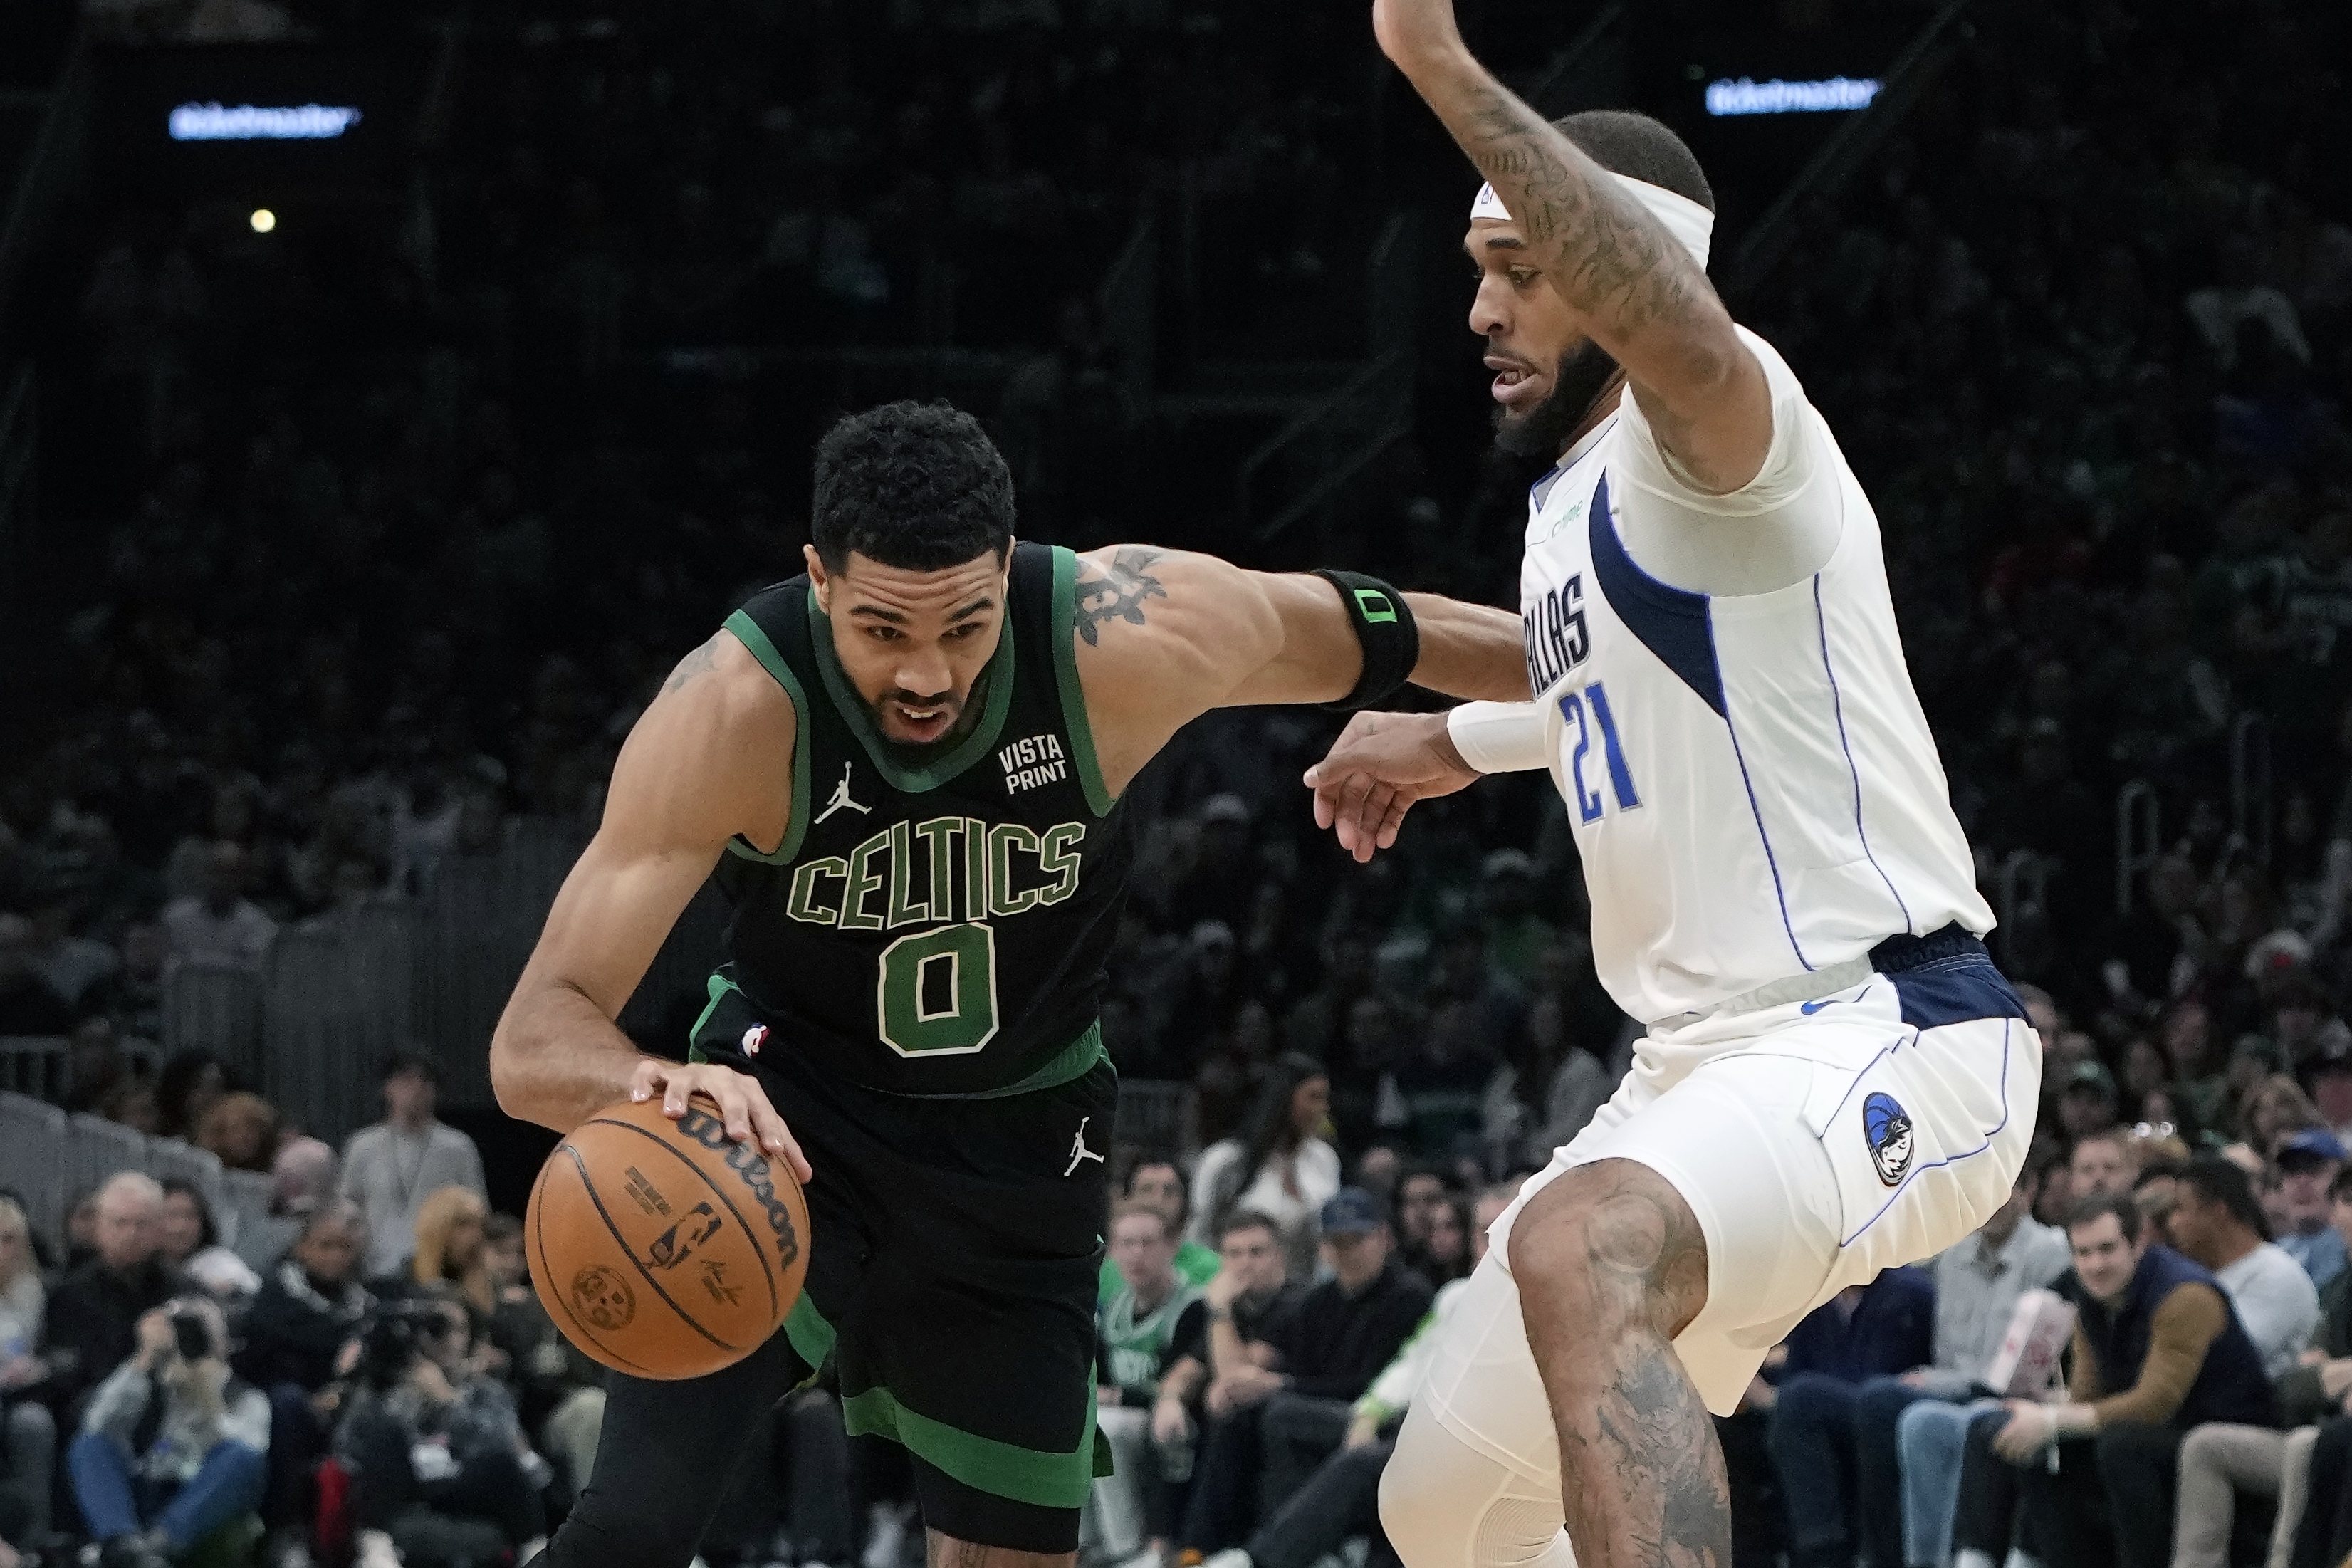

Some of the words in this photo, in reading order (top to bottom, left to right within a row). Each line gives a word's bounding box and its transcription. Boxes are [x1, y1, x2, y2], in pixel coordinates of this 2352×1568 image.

[1522, 572, 1591, 703] ALLAS
[998, 733, 1065, 774] VISTA
[1005, 759, 1067, 795] PRINT
[1557, 679, 1643, 827] 21
[786, 816, 1086, 930] CELTICS
[877, 921, 999, 1058] 0
